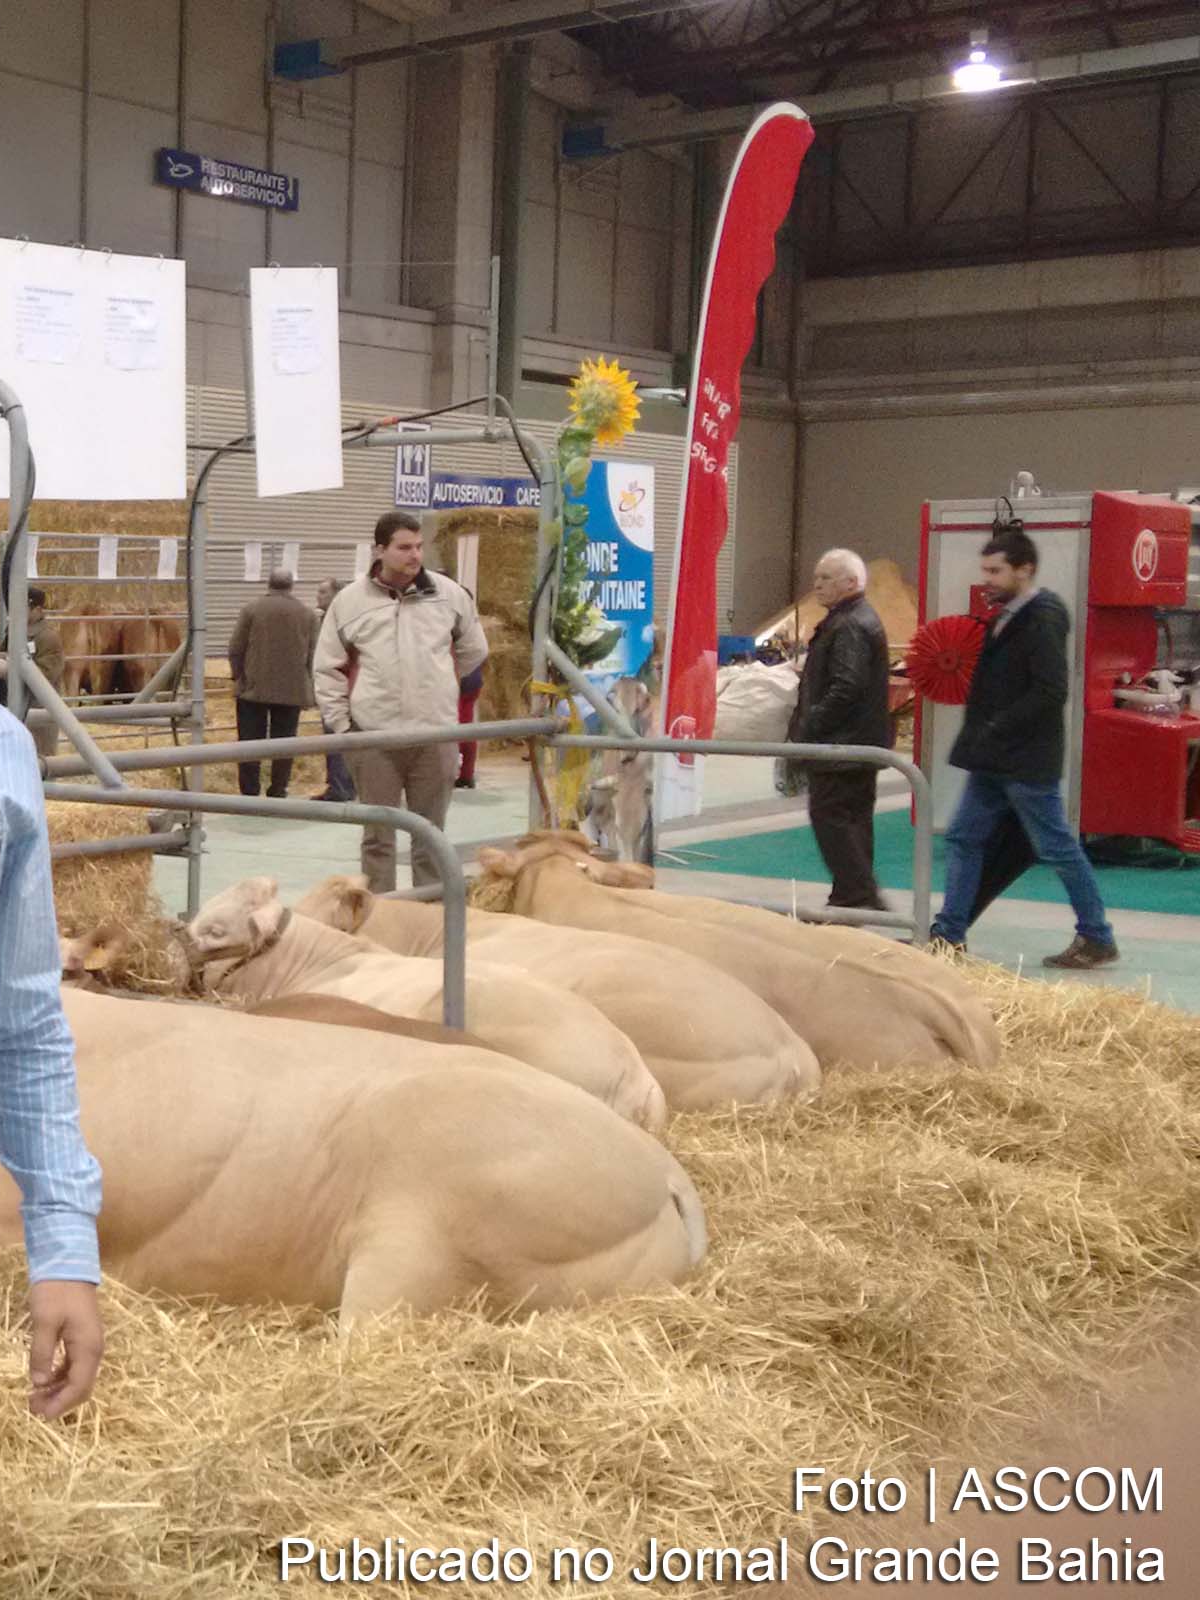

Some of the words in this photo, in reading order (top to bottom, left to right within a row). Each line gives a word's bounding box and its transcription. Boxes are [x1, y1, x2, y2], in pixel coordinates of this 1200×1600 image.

[200, 157, 286, 190] RESTAURANTE
[200, 176, 286, 206] AUTOSERVICIO
[398, 480, 428, 503] ASEOS
[433, 482, 504, 505] AUTOSERVICIO
[581, 542, 618, 572] ONDE
